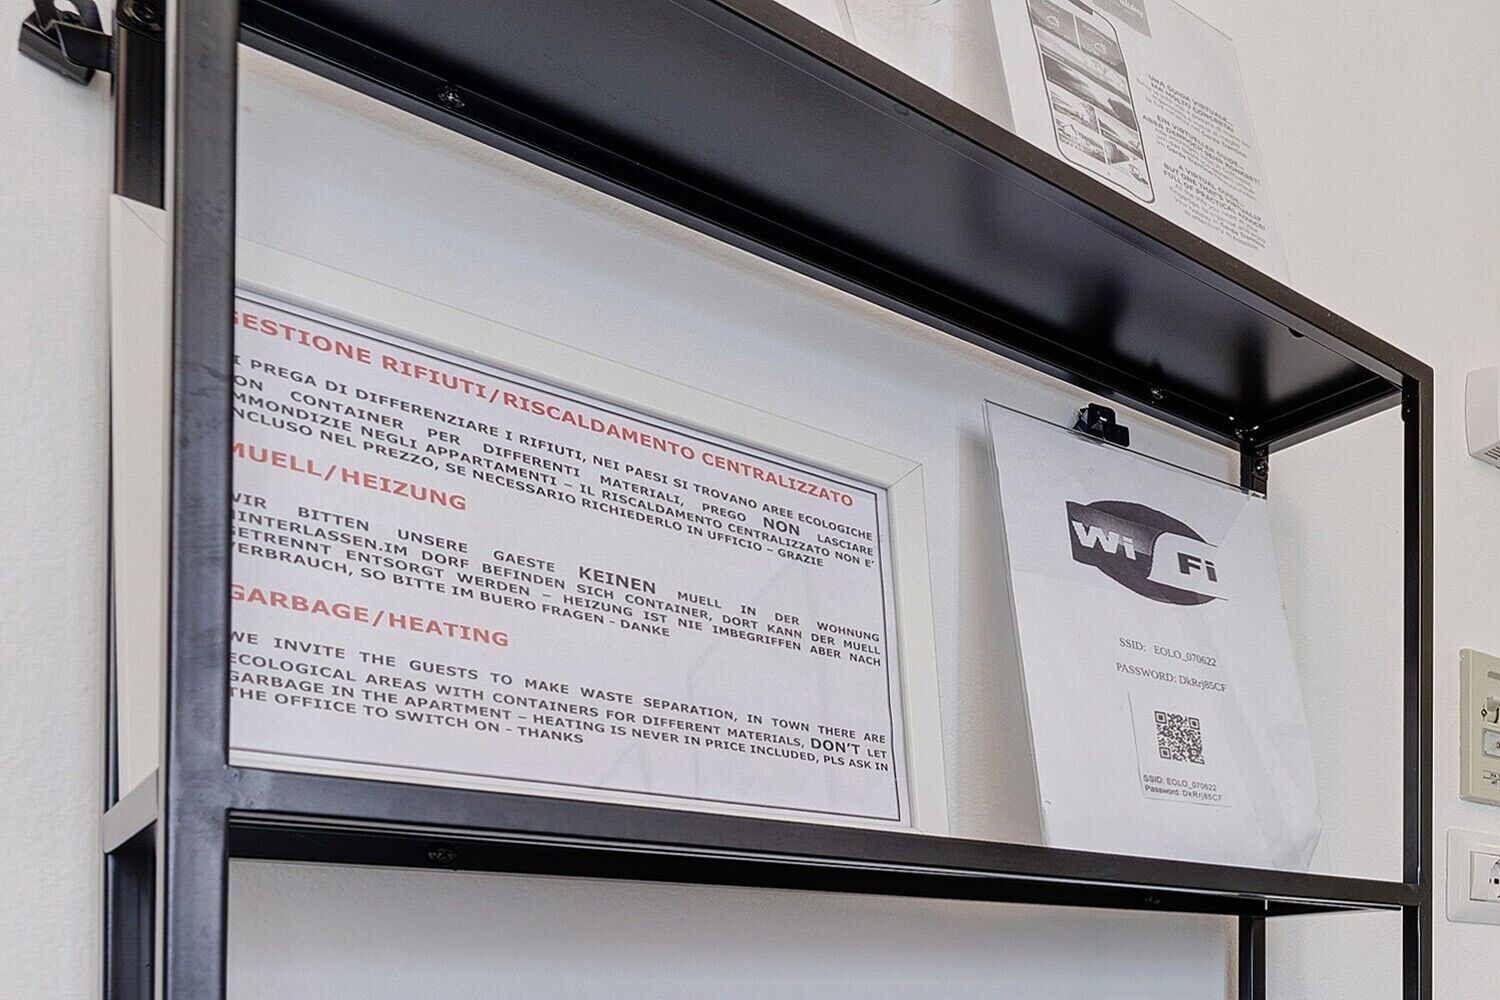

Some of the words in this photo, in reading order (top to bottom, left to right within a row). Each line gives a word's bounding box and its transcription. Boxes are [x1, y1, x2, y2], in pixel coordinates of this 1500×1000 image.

[250, 359, 317, 387] PREGA
[355, 388, 499, 438] DIFFERENZIARE
[519, 434, 587, 464] RIFIUTI,
[625, 464, 668, 485] PAESI
[692, 482, 758, 509] TROVANO
[761, 503, 794, 519] AREE
[797, 512, 873, 541] ECOLOGICHE
[382, 355, 695, 460] RIFIUTI/RISCALDAMENTO
[701, 452, 853, 507] CENTRALIZZATO
[290, 390, 404, 431] CONTAINER
[483, 443, 580, 478] DIFFERENTI
[600, 474, 684, 508] MATERIALI,
[702, 502, 747, 522] PREGO
[763, 516, 800, 537] NON
[817, 533, 874, 557] LASCIARE
[361, 425, 418, 450] NEGLI
[425, 443, 557, 487] APPARTAMENTI
[601, 489, 723, 529] RISCALDAMENTO
[727, 523, 830, 557] CENTRALIZZATO
[363, 440, 439, 471] PREZZO,
[472, 468, 576, 504] NECESSARIO
[581, 497, 683, 532] RICHIEDERLO
[707, 529, 763, 552] UFFICIO
[777, 548, 824, 567] GRAZIE
[298, 506, 369, 532] BITTEN
[398, 528, 468, 554] UNSERE
[493, 550, 555, 573] GAESTE
[579, 565, 656, 595] KEINEN
[677, 590, 722, 609] MUELL
[816, 621, 880, 643] WOHNUNG
[1072, 520, 1138, 561] Wi
[1177, 551, 1219, 584] Fi
[231, 584, 508, 647] GARBAGE/HEATING
[346, 549, 445, 579] ENTSORGT
[456, 572, 530, 597] WERDEN
[563, 594, 633, 617] HEIZUNG
[712, 624, 801, 651] IMBEGRIFFEN
[809, 645, 842, 659] ABER
[849, 652, 881, 667] NACH
[392, 573, 446, 594] BITTE
[480, 591, 537, 611] BUERO
[541, 603, 604, 624] FRAGEN
[620, 619, 670, 637] DANKE
[421, 550, 469, 569] DORF
[482, 563, 565, 590] BEFINDEN
[576, 583, 614, 600] SICH
[624, 593, 713, 622] CONTAINER,
[722, 614, 759, 630] DORT
[767, 623, 802, 640] KANN
[843, 639, 881, 655] MUELL
[1116, 662, 1178, 683] PASSWORD:
[1119, 637, 1146, 652] SSID:
[273, 637, 345, 660] INVITE
[409, 659, 478, 680] GUESTS
[525, 678, 569, 695] MAKE
[580, 687, 633, 705] WASTE
[643, 697, 738, 723] SEPARATION,
[771, 717, 810, 732] TOWN
[817, 724, 856, 740] THERE
[274, 693, 356, 714] OFFIICE
[395, 709, 469, 729] SWITCH
[517, 725, 584, 744] THANKS
[365, 673, 427, 692] AREAS
[434, 683, 484, 701] WITH
[492, 692, 599, 718] CONTAINERS
[642, 715, 721, 735] DIFFERENT
[727, 727, 805, 749] MATERIALS,
[810, 737, 861, 755] DON'T
[404, 696, 512, 720] APARTMENT
[533, 713, 605, 733] HEATING
[631, 728, 680, 744] NEVER
[705, 738, 746, 753] PRICE
[749, 744, 819, 764] INCLUDED,
[1143, 774, 1165, 784] SSID:
